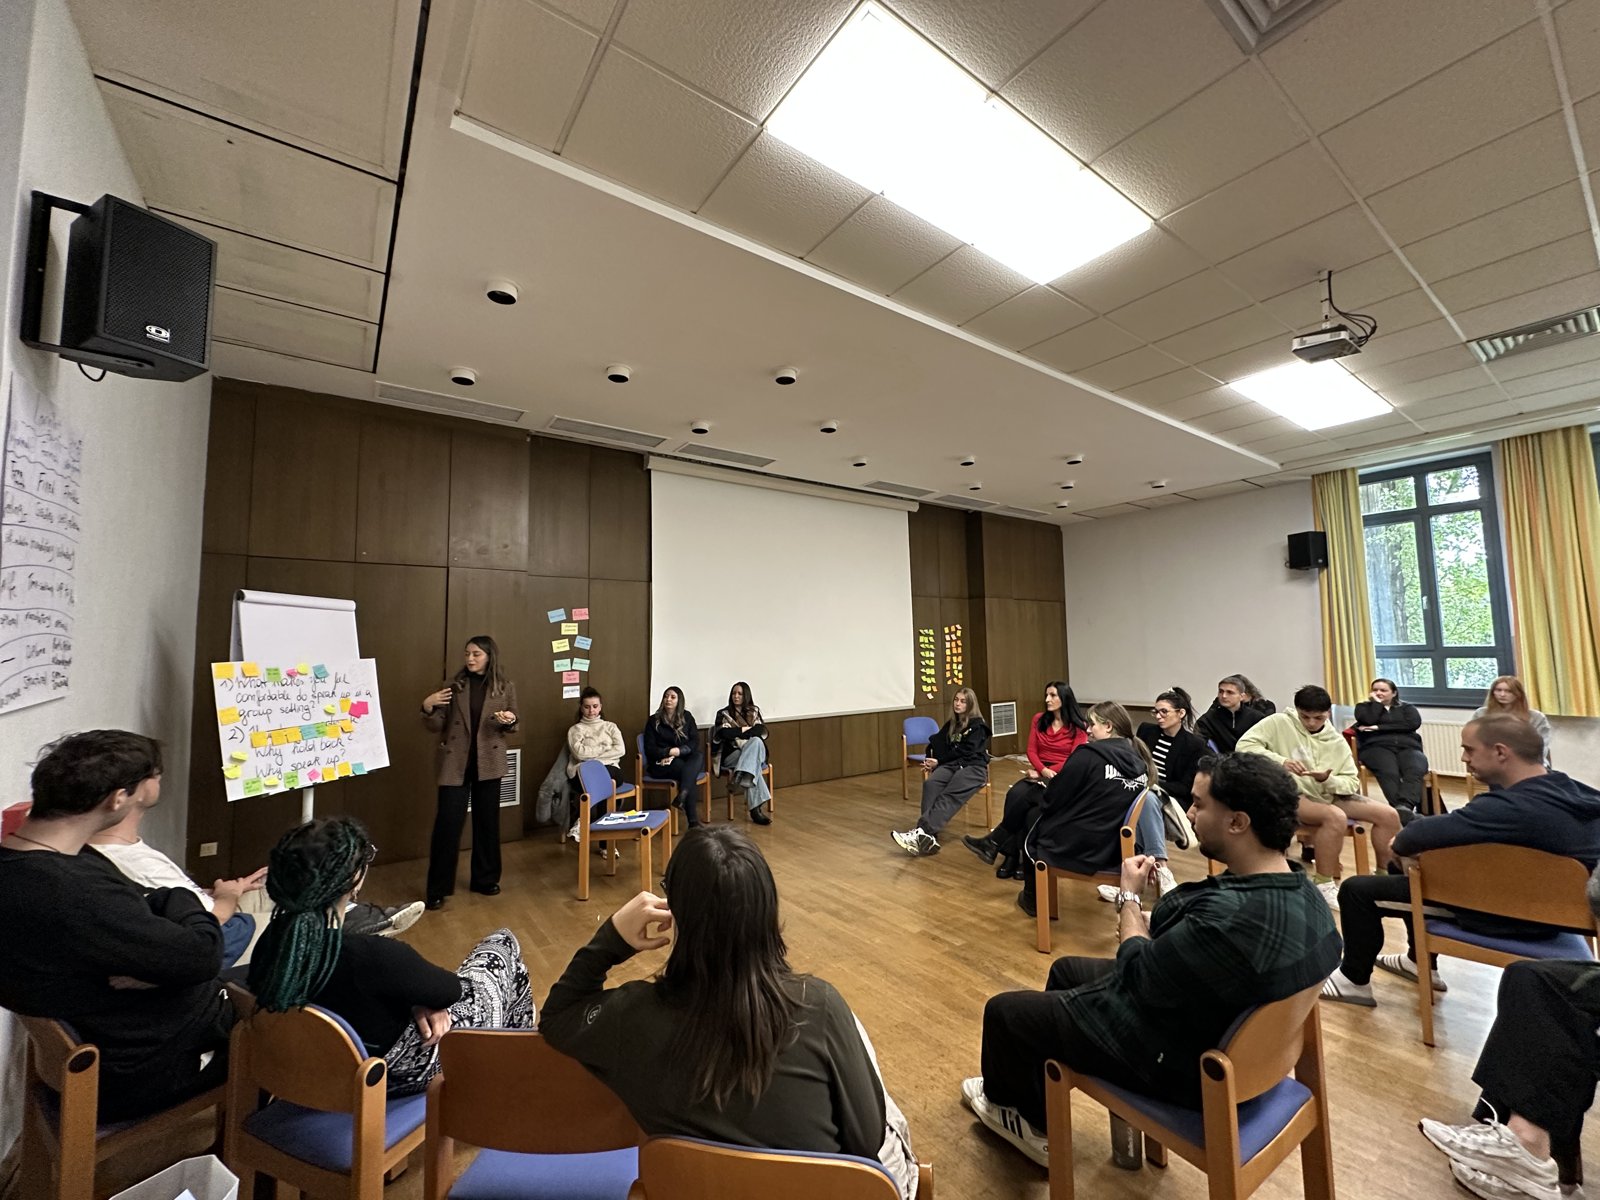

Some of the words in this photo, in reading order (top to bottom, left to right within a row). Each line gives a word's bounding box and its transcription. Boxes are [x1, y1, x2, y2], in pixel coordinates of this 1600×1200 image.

[220, 677, 234, 691] 1)
[235, 674, 267, 689] What
[312, 689, 337, 704] speak
[239, 707, 272, 726] group
[279, 700, 316, 721] setting?
[228, 726, 245, 743] 2)
[255, 745, 283, 766] Why
[255, 764, 283, 781] Why
[290, 756, 321, 772] speak
[325, 748, 346, 771] up?
